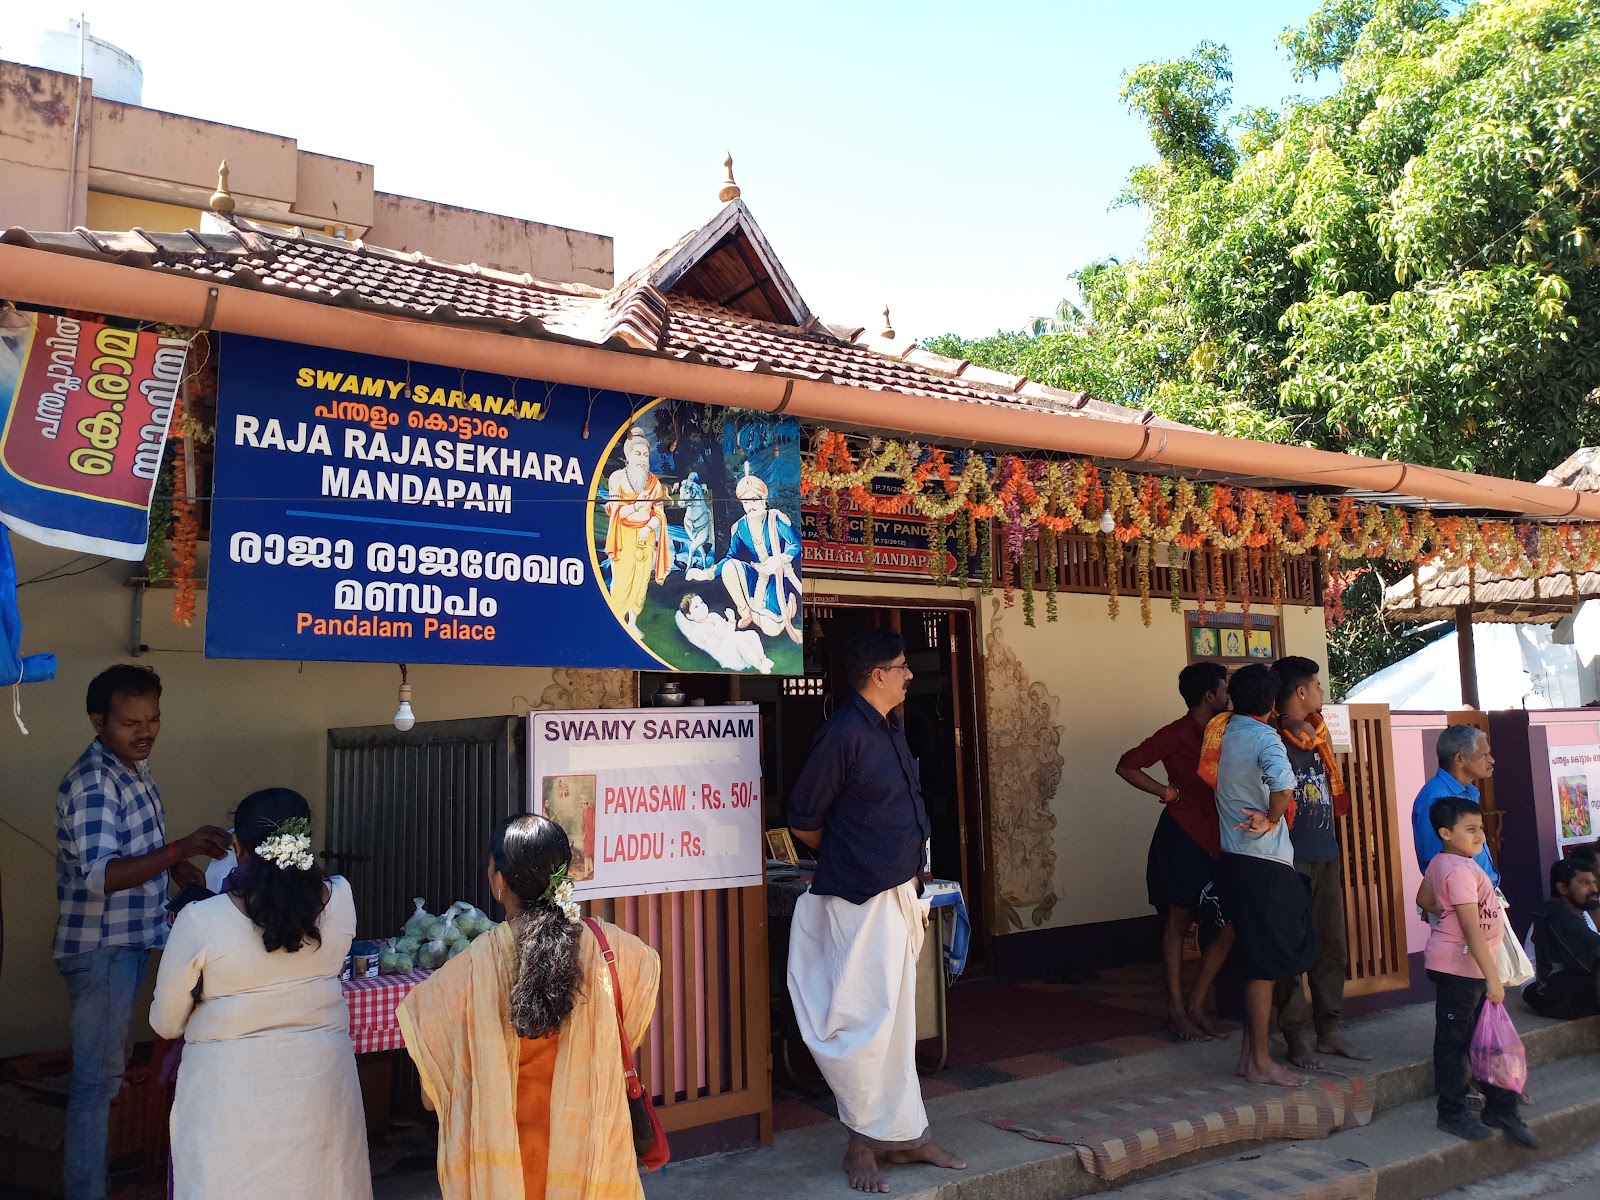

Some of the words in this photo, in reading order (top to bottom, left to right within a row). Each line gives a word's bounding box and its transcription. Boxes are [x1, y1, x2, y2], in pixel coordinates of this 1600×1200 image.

[296, 367, 405, 400] SWAMY
[412, 384, 541, 420] SARANAM
[314, 400, 400, 429] പന്തളം
[408, 410, 509, 440] കൊട്ടാരം
[234, 414, 332, 456] RAJA
[344, 427, 585, 486] RAJASEKHARA
[321, 465, 512, 514] MANDAPAM
[229, 531, 354, 570] രാജാ
[366, 541, 585, 586] രാജശേഖര
[801, 547, 865, 563] EKHARA
[334, 579, 498, 618] മണ്ഡപം
[297, 613, 413, 638] Pandalam
[424, 617, 496, 641] Palace
[544, 720, 636, 742] SWAMY
[642, 718, 754, 740] SARANAM
[604, 784, 686, 815] PAYASAM
[701, 783, 727, 810] Rs.
[731, 781, 759, 808] 50/-
[603, 832, 665, 863] LADDU
[680, 830, 705, 857] Rs.
